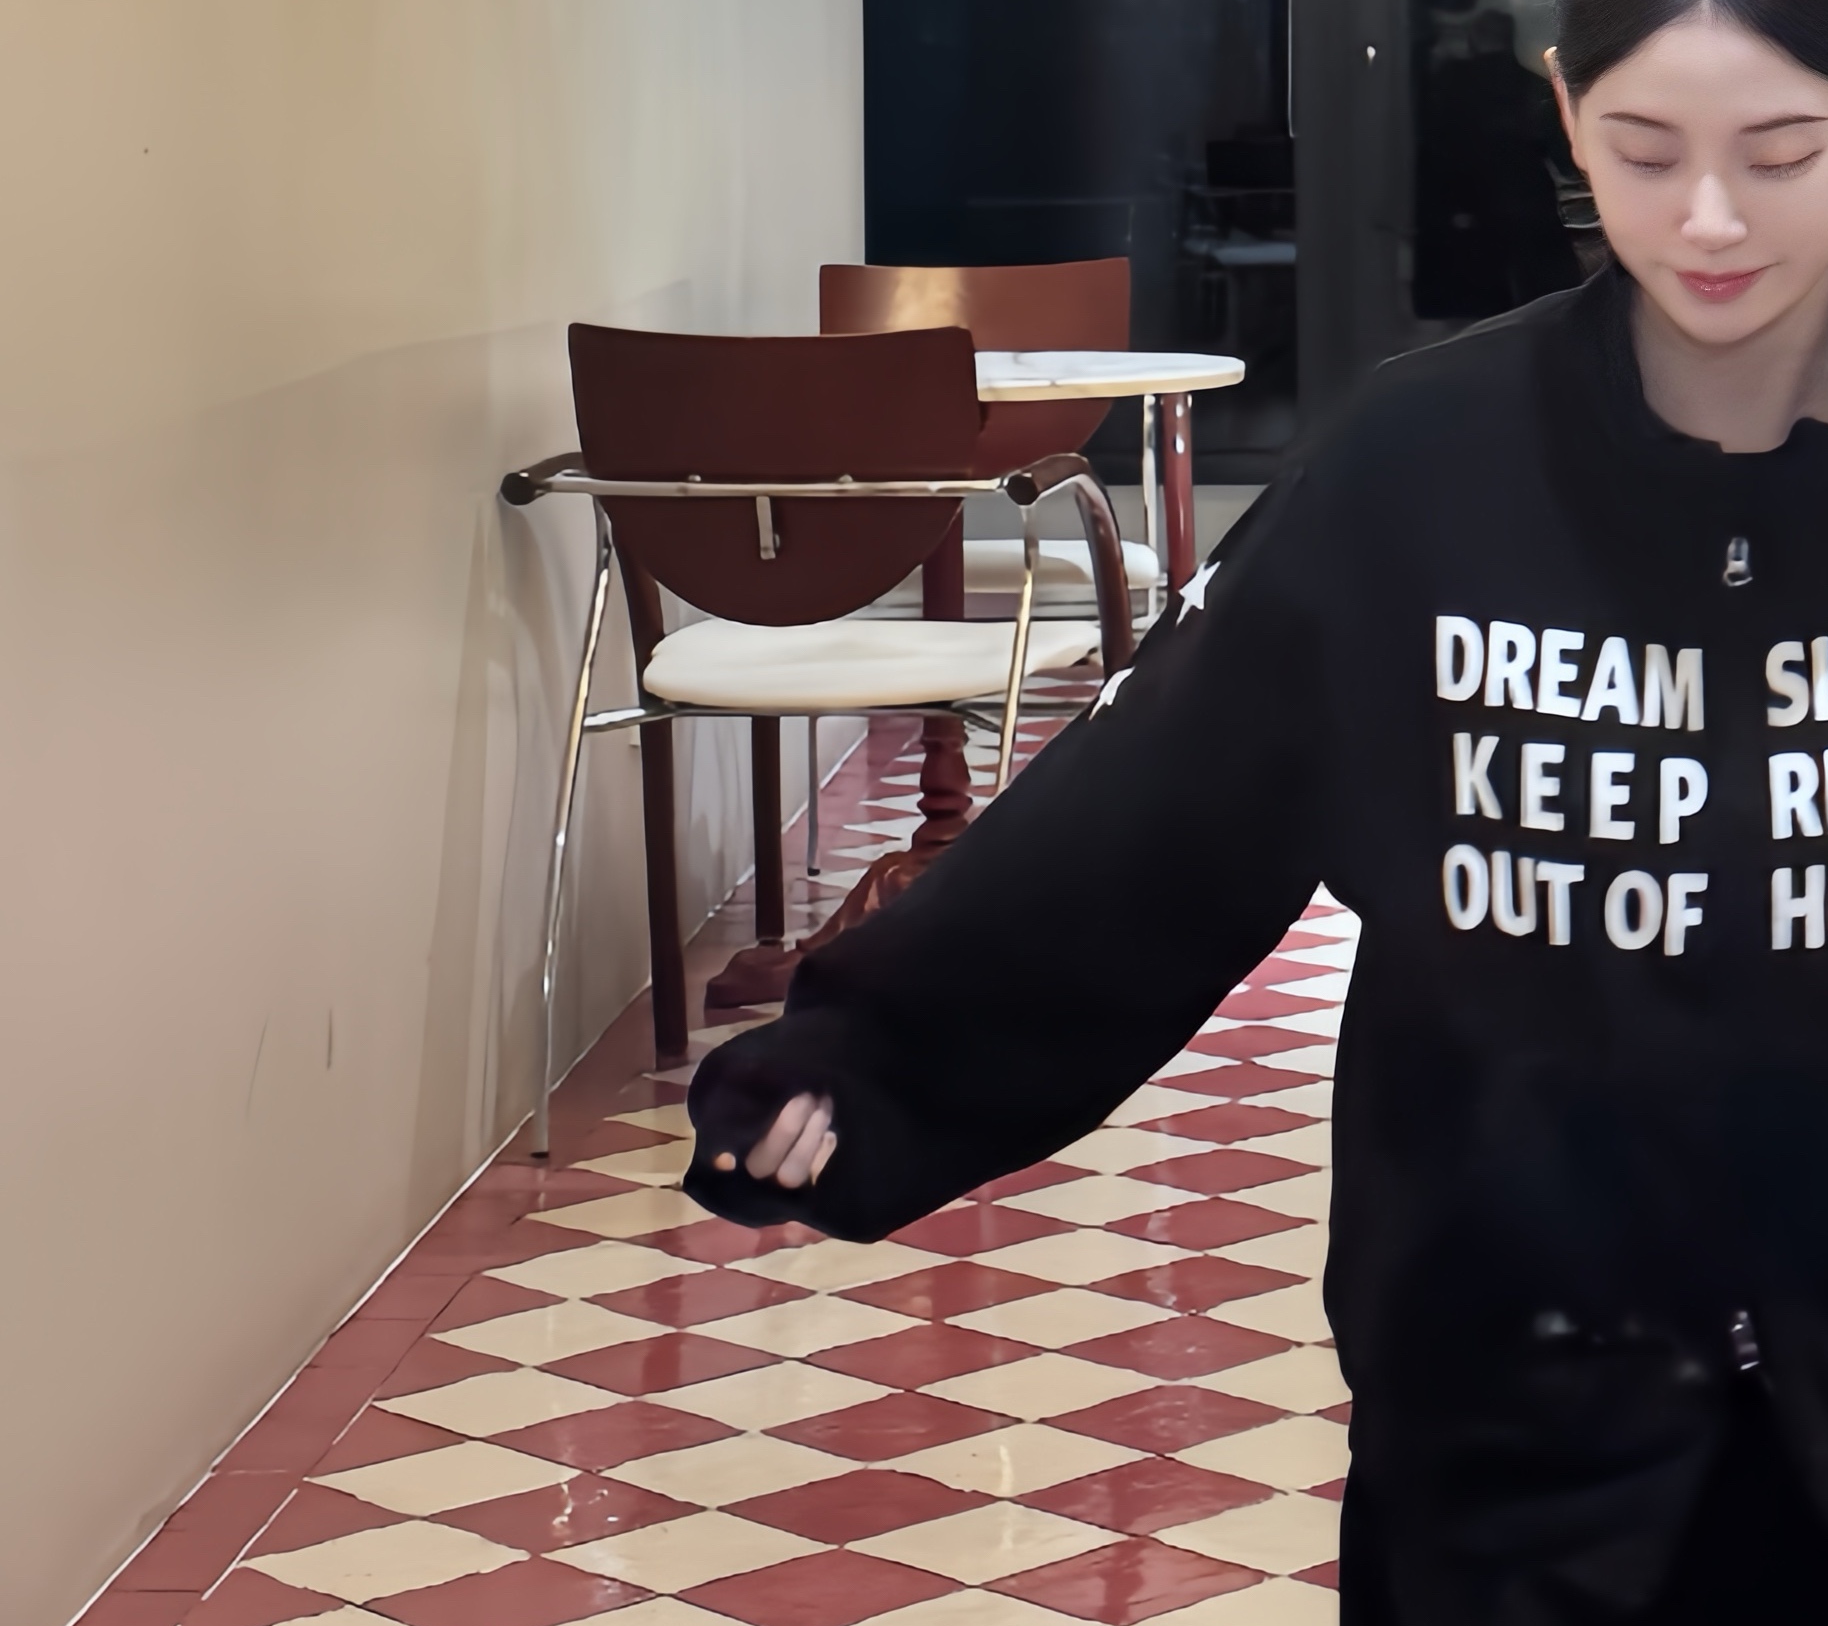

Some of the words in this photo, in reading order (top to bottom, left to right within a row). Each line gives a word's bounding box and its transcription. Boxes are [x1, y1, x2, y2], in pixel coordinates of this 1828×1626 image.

[1435, 615, 1705, 732] DREAM
[1442, 843, 1586, 946] OUT
[1604, 870, 1709, 957] OF
